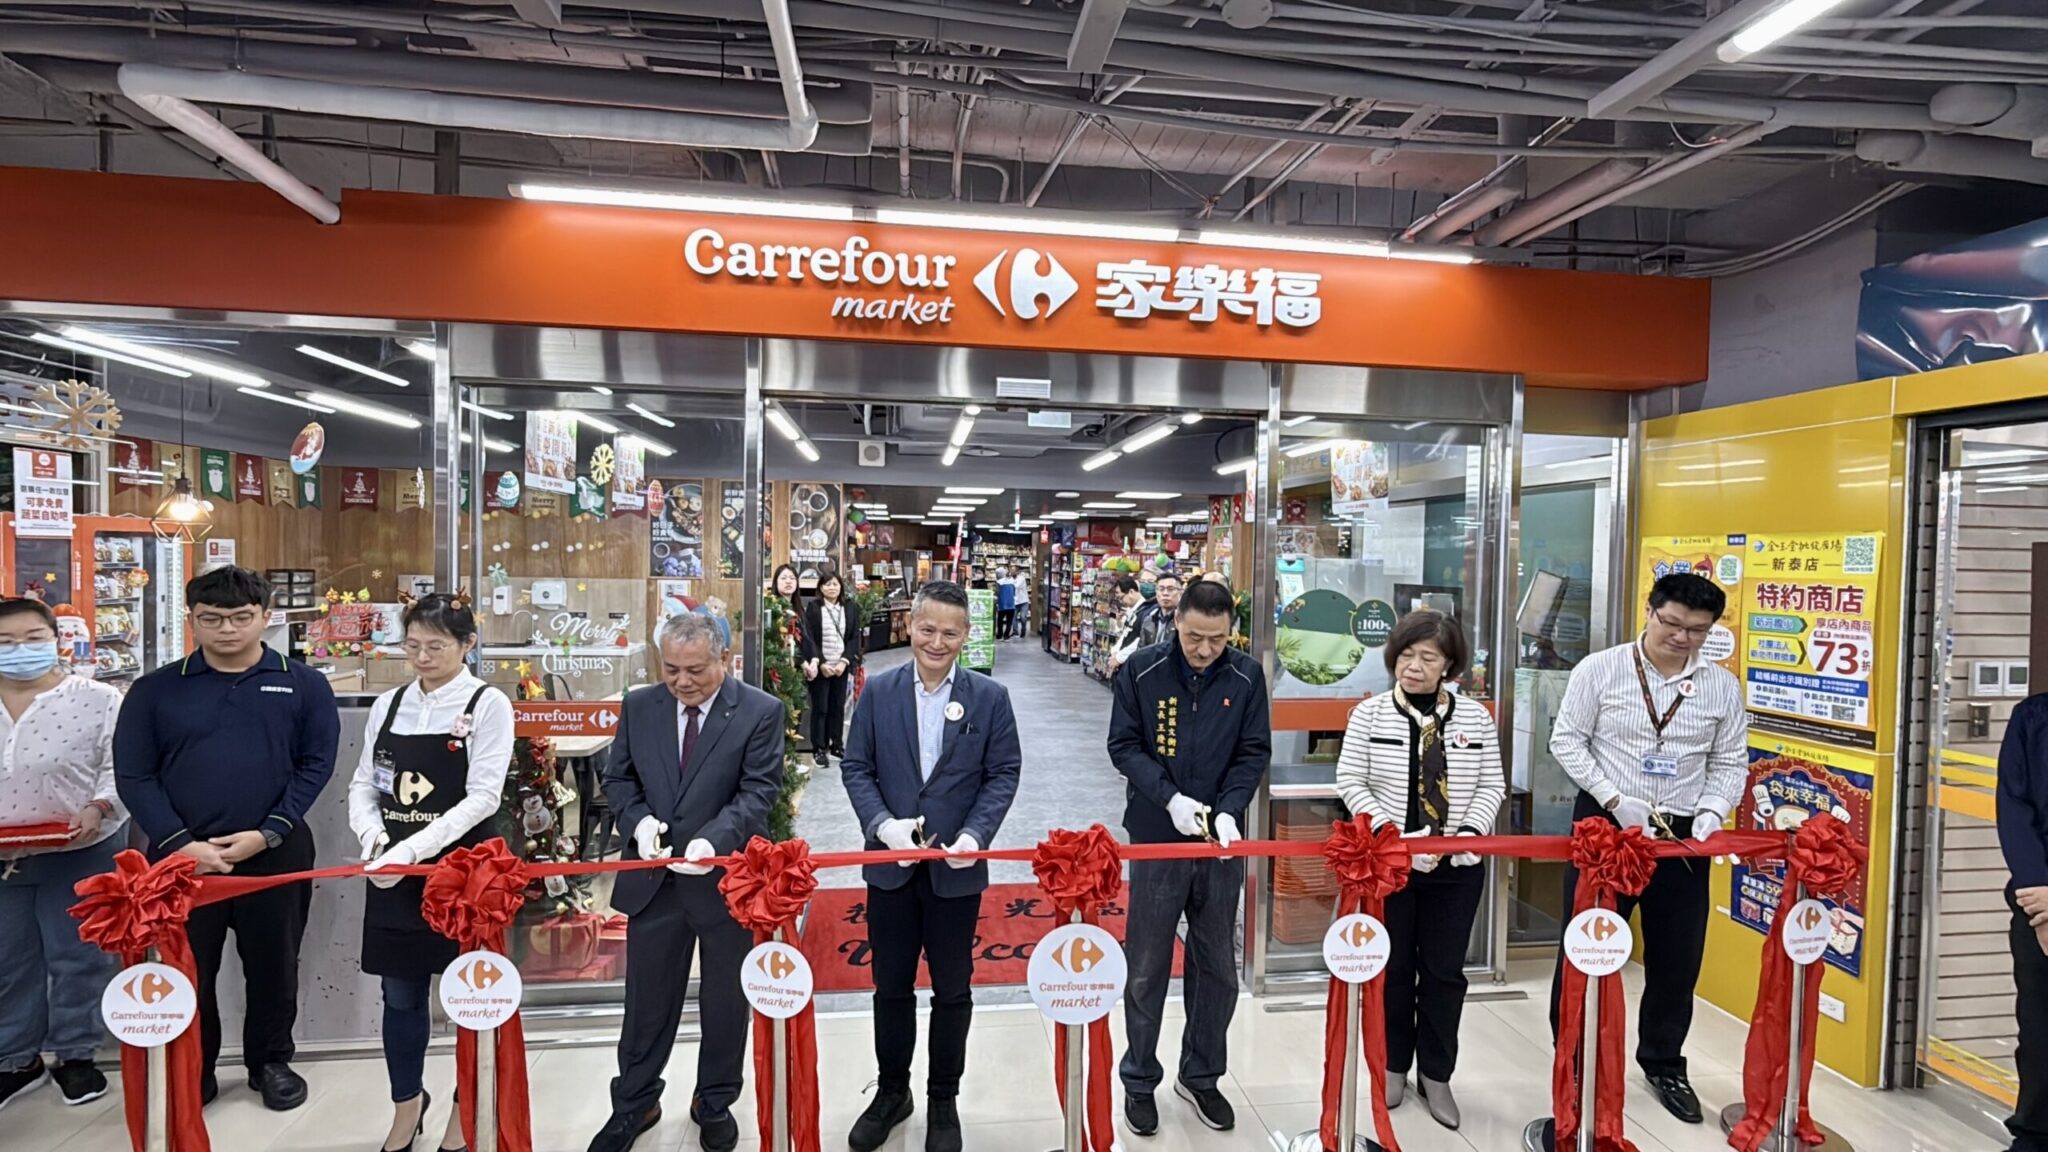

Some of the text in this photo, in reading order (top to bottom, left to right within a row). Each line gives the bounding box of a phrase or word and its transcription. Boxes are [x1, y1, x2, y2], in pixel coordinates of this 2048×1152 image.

[684, 228, 957, 288] Carrefour
[1096, 259, 1323, 327] 家樂福
[831, 292, 956, 324] market
[26, 496, 64, 509] 可享免費
[21, 509, 69, 522] 蔬菜自助吧
[1772, 558, 1819, 571] 新泰店
[1757, 583, 1865, 614] 特約商店
[551, 613, 622, 641] Merry
[1816, 618, 1872, 631] 享店內商品
[1813, 639, 1871, 675] 73 折
[542, 651, 614, 677] Christmas
[513, 709, 585, 723] Carrefour
[550, 723, 585, 732] market
[1769, 780, 1831, 812] 袋來幸福
[748, 982, 784, 994] Carrefour
[1039, 981, 1088, 992] Carrefour
[447, 996, 489, 1005] Carrefour
[756, 996, 795, 1008] market
[1051, 995, 1101, 1008] market
[111, 1011, 158, 1020] Carrefour
[457, 1008, 502, 1018] market
[122, 1023, 172, 1034] market
